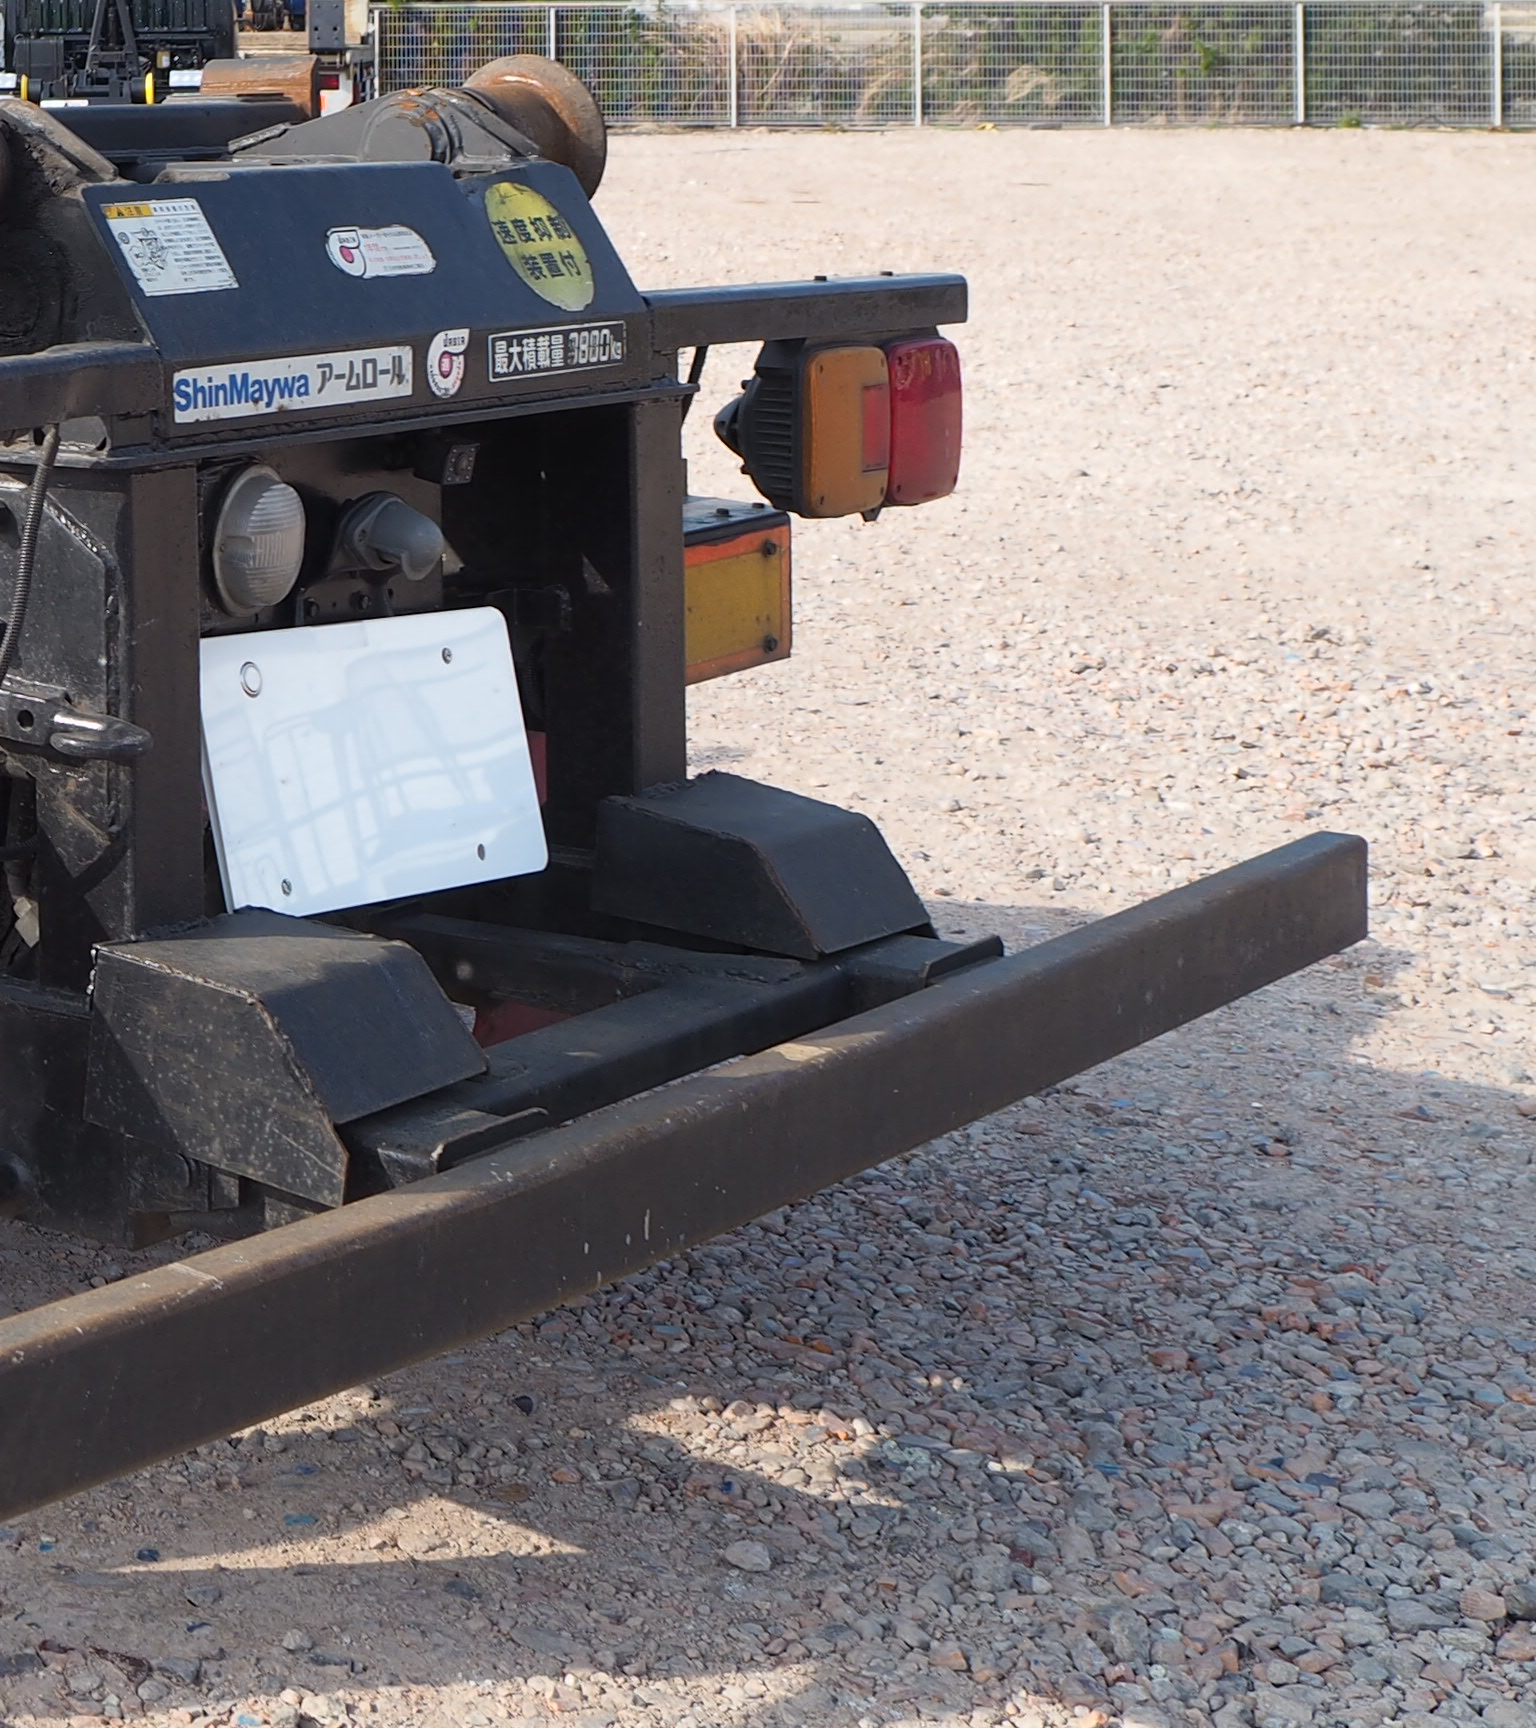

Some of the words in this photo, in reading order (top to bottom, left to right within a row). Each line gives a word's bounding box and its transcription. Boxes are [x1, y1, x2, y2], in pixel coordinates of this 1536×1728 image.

[494, 333, 565, 374] 最大積載量
[174, 373, 310, 412] ShinMaywa
[316, 355, 406, 395] アームロール
